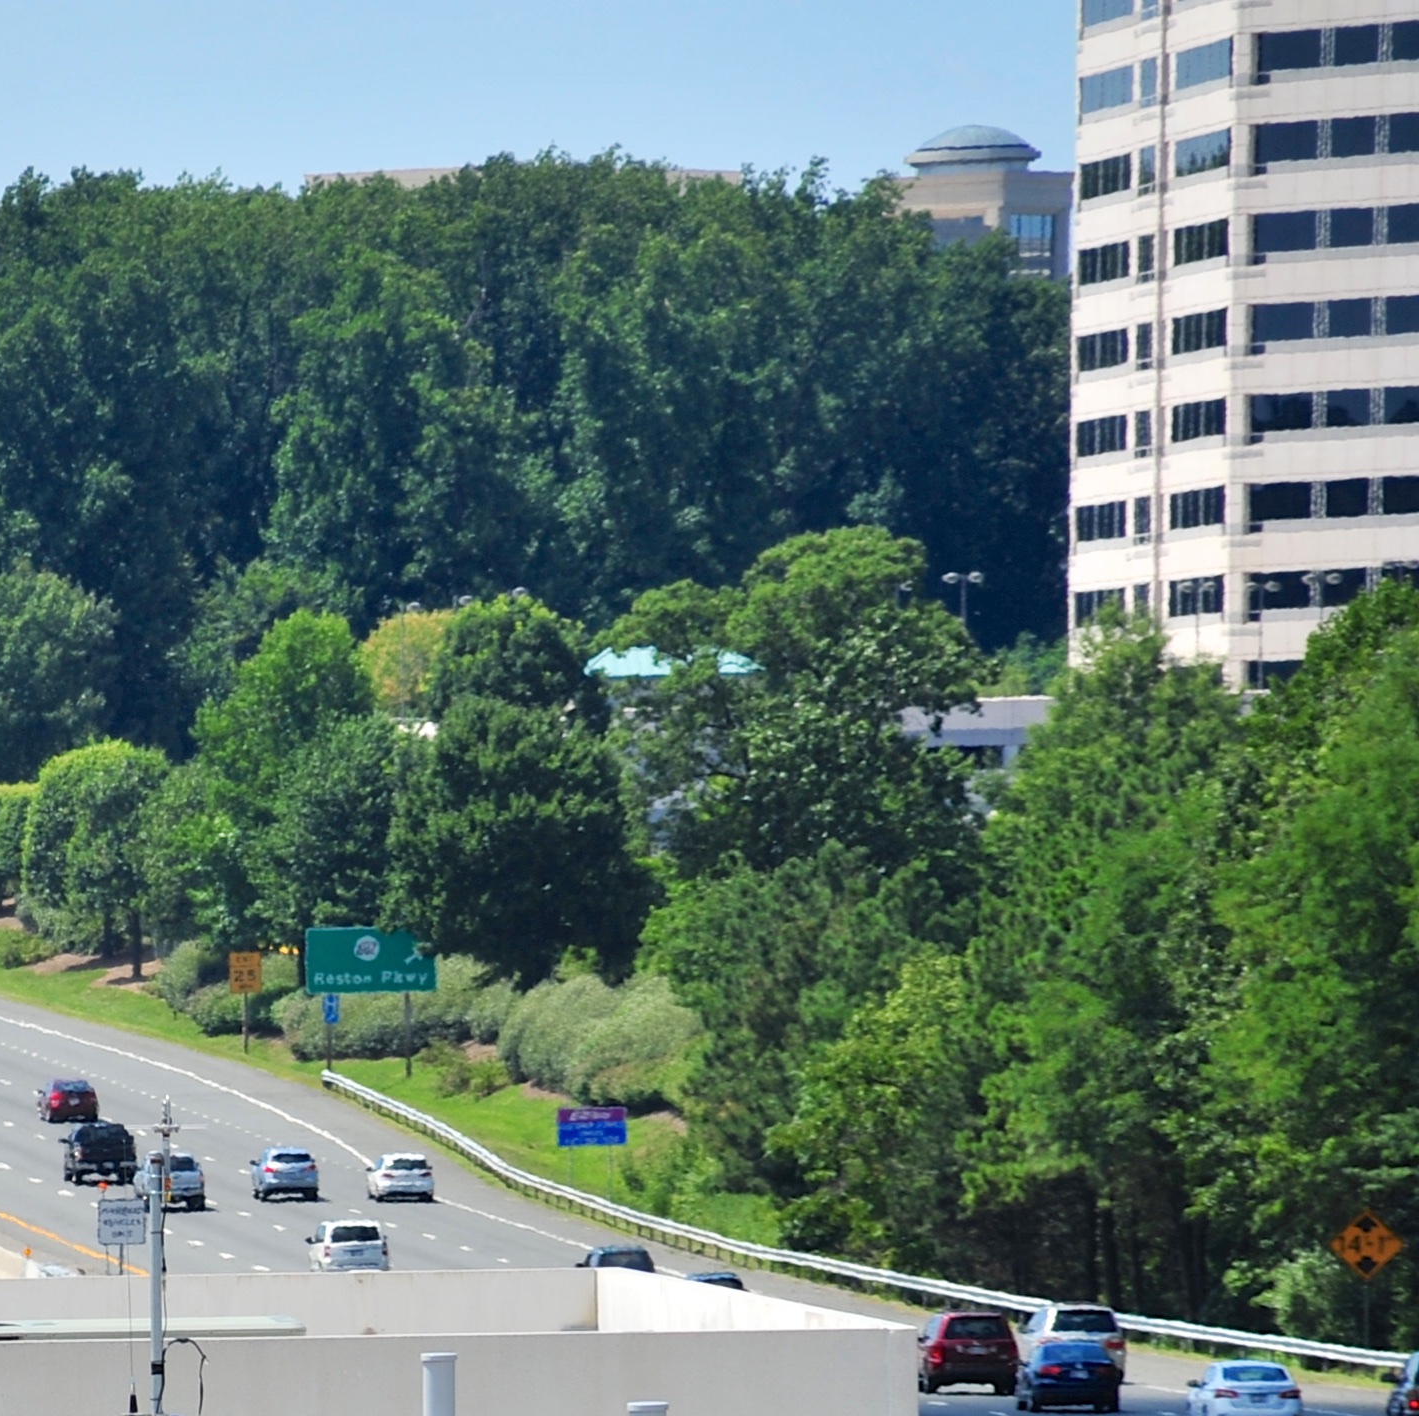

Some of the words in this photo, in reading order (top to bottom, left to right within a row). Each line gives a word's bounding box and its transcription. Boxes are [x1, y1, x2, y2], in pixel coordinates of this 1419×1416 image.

[234, 969, 256, 982] 25
[314, 972, 372, 985] Reston
[381, 971, 428, 985] Pkwy
